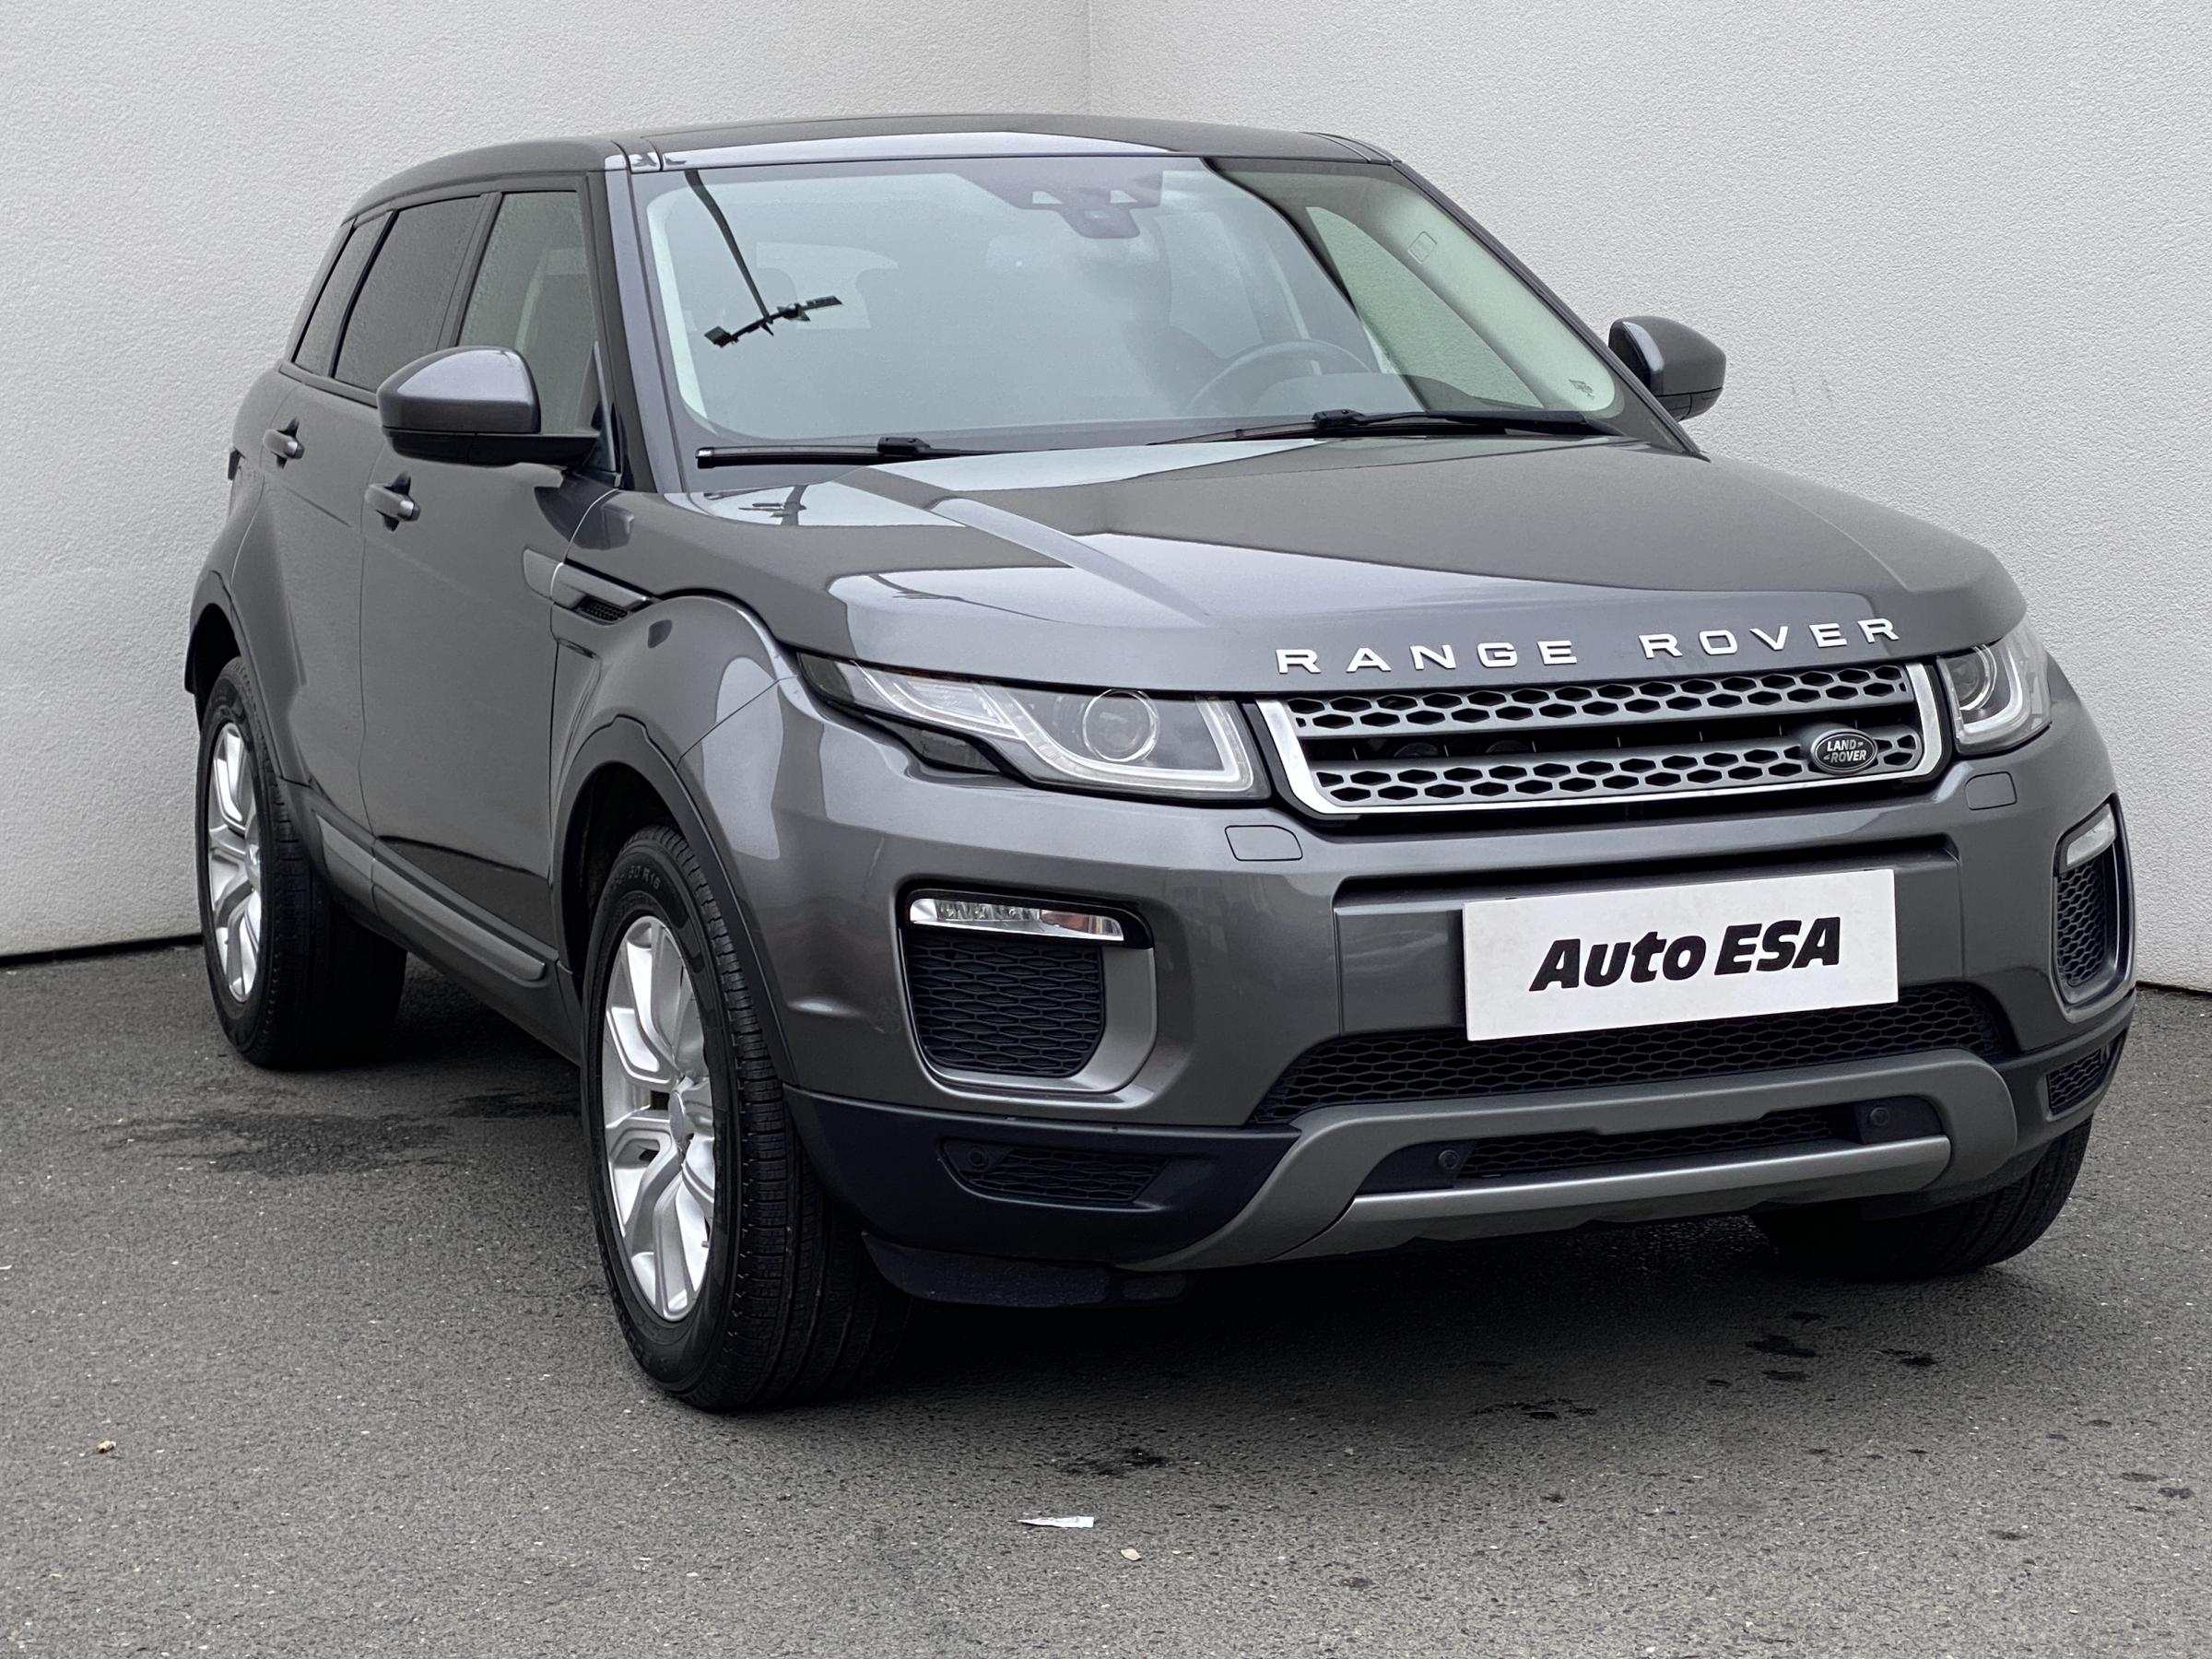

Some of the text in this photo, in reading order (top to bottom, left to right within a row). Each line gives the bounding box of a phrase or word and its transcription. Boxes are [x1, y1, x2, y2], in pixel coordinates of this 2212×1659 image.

[1276, 618, 1900, 675] RANGE ROVER
[1827, 739, 1857, 752] LAND
[1830, 749, 1867, 763] ROVER
[1528, 916, 1841, 992] Auto ESA
